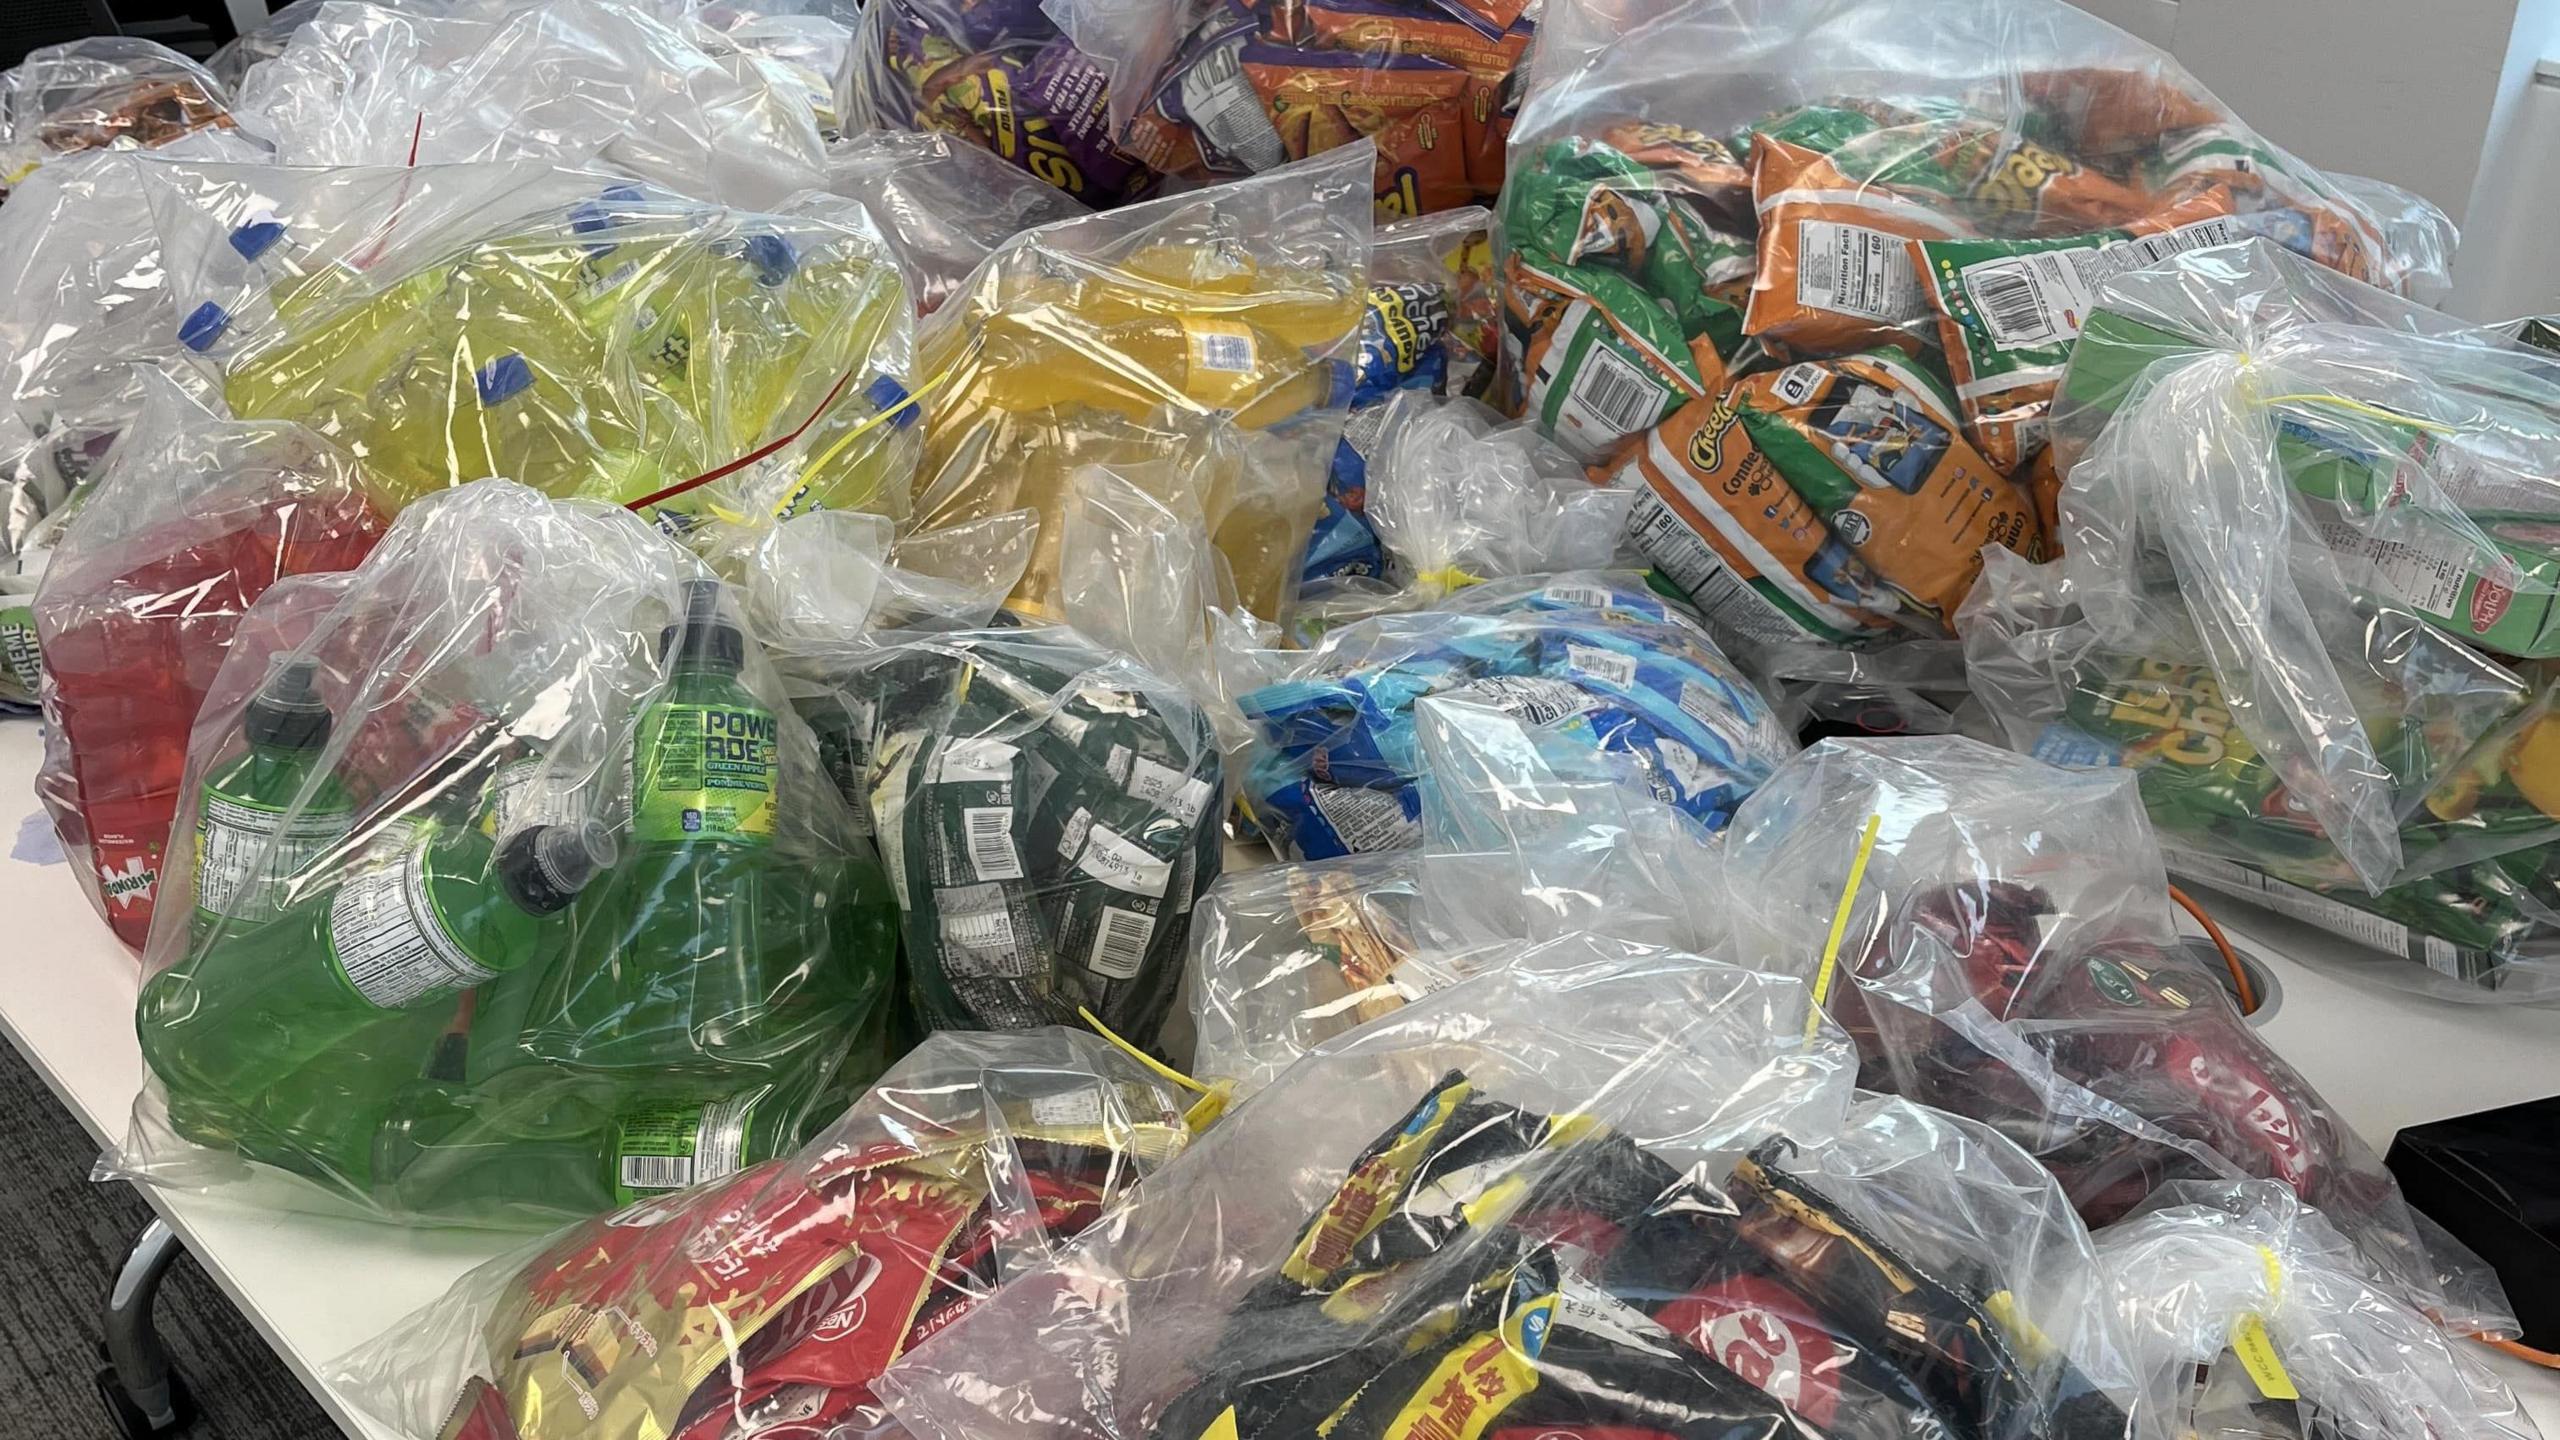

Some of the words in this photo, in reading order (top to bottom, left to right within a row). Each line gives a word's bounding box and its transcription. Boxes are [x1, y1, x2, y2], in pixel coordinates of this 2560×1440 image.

[1841, 229, 1849, 255] Facts
[1872, 236, 1881, 255] 160
[1838, 258, 1848, 305] Nutrition
[1720, 444, 1765, 497] Connec
[1655, 514, 1673, 531] 160
[2445, 573, 2463, 609] nutritive
[704, 710, 778, 742] POWE
[705, 736, 760, 763] ADE
